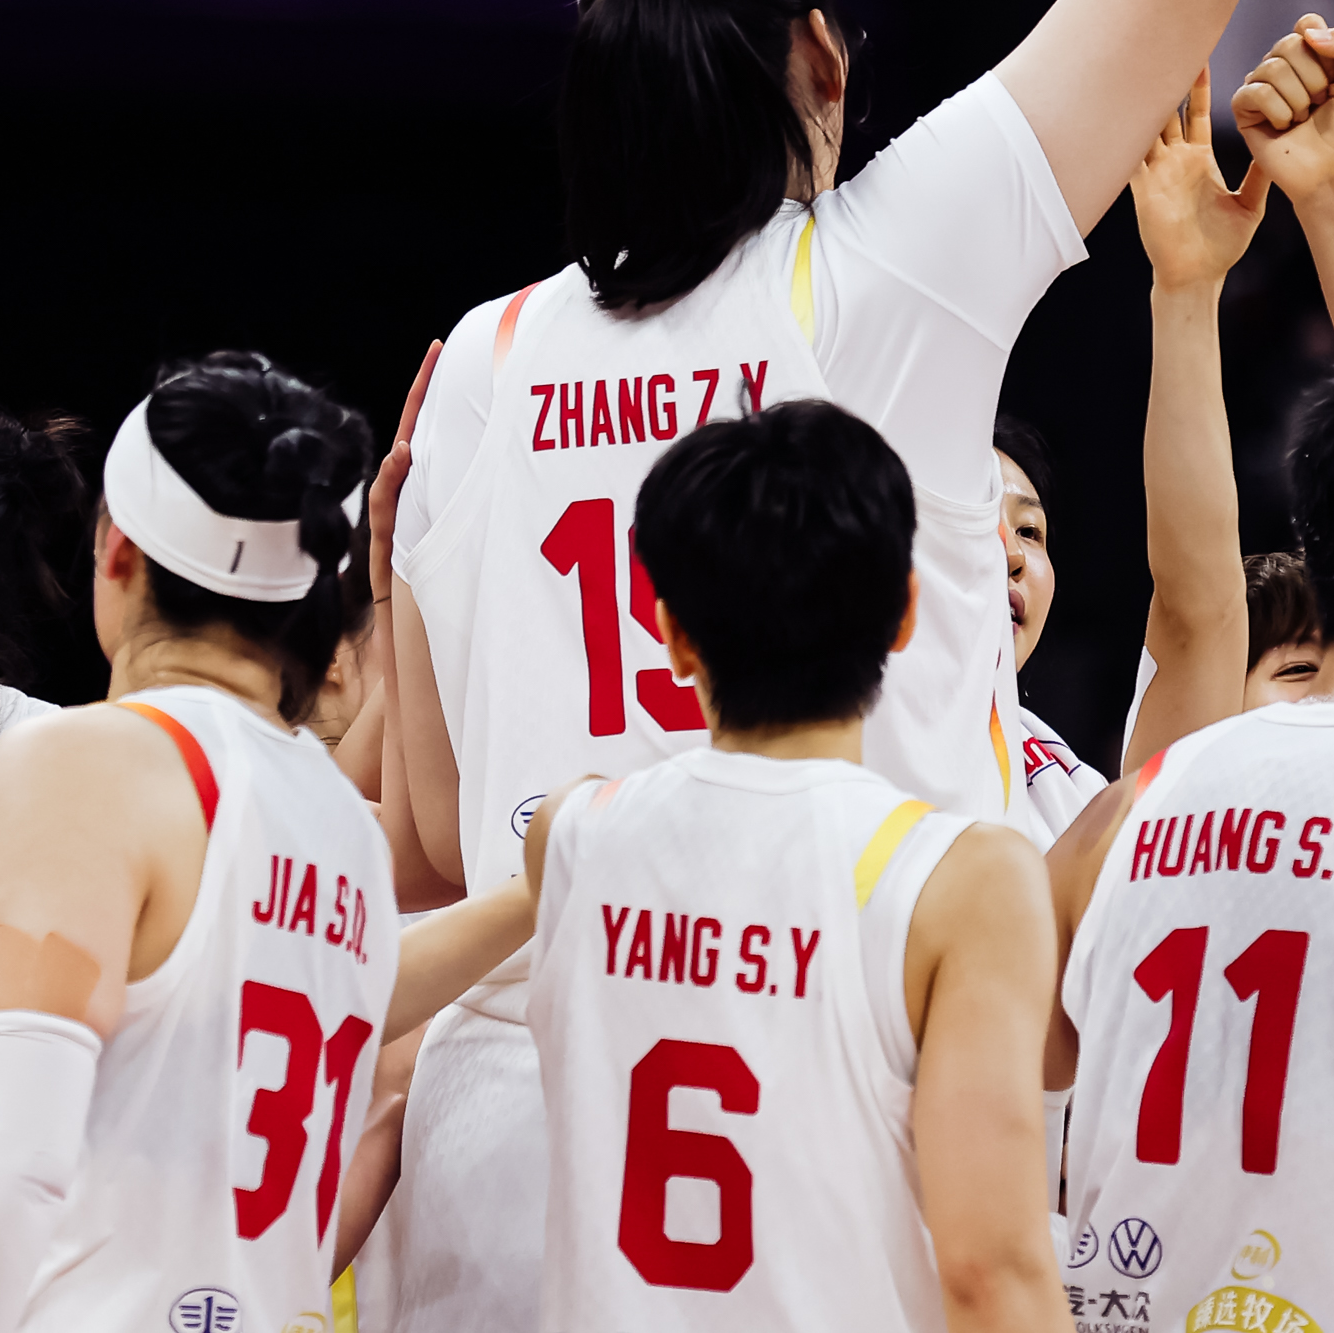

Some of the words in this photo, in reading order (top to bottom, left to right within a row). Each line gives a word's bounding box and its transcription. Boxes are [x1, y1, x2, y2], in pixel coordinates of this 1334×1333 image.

[531, 373, 678, 452] ZHANG
[1129, 808, 1286, 882] HUANG
[252, 854, 318, 936] JIA
[601, 904, 723, 988] YANG
[735, 924, 821, 999] S.Y
[1132, 925, 1311, 1176] 11
[231, 979, 374, 1250] 31
[617, 1037, 761, 1294] 6
